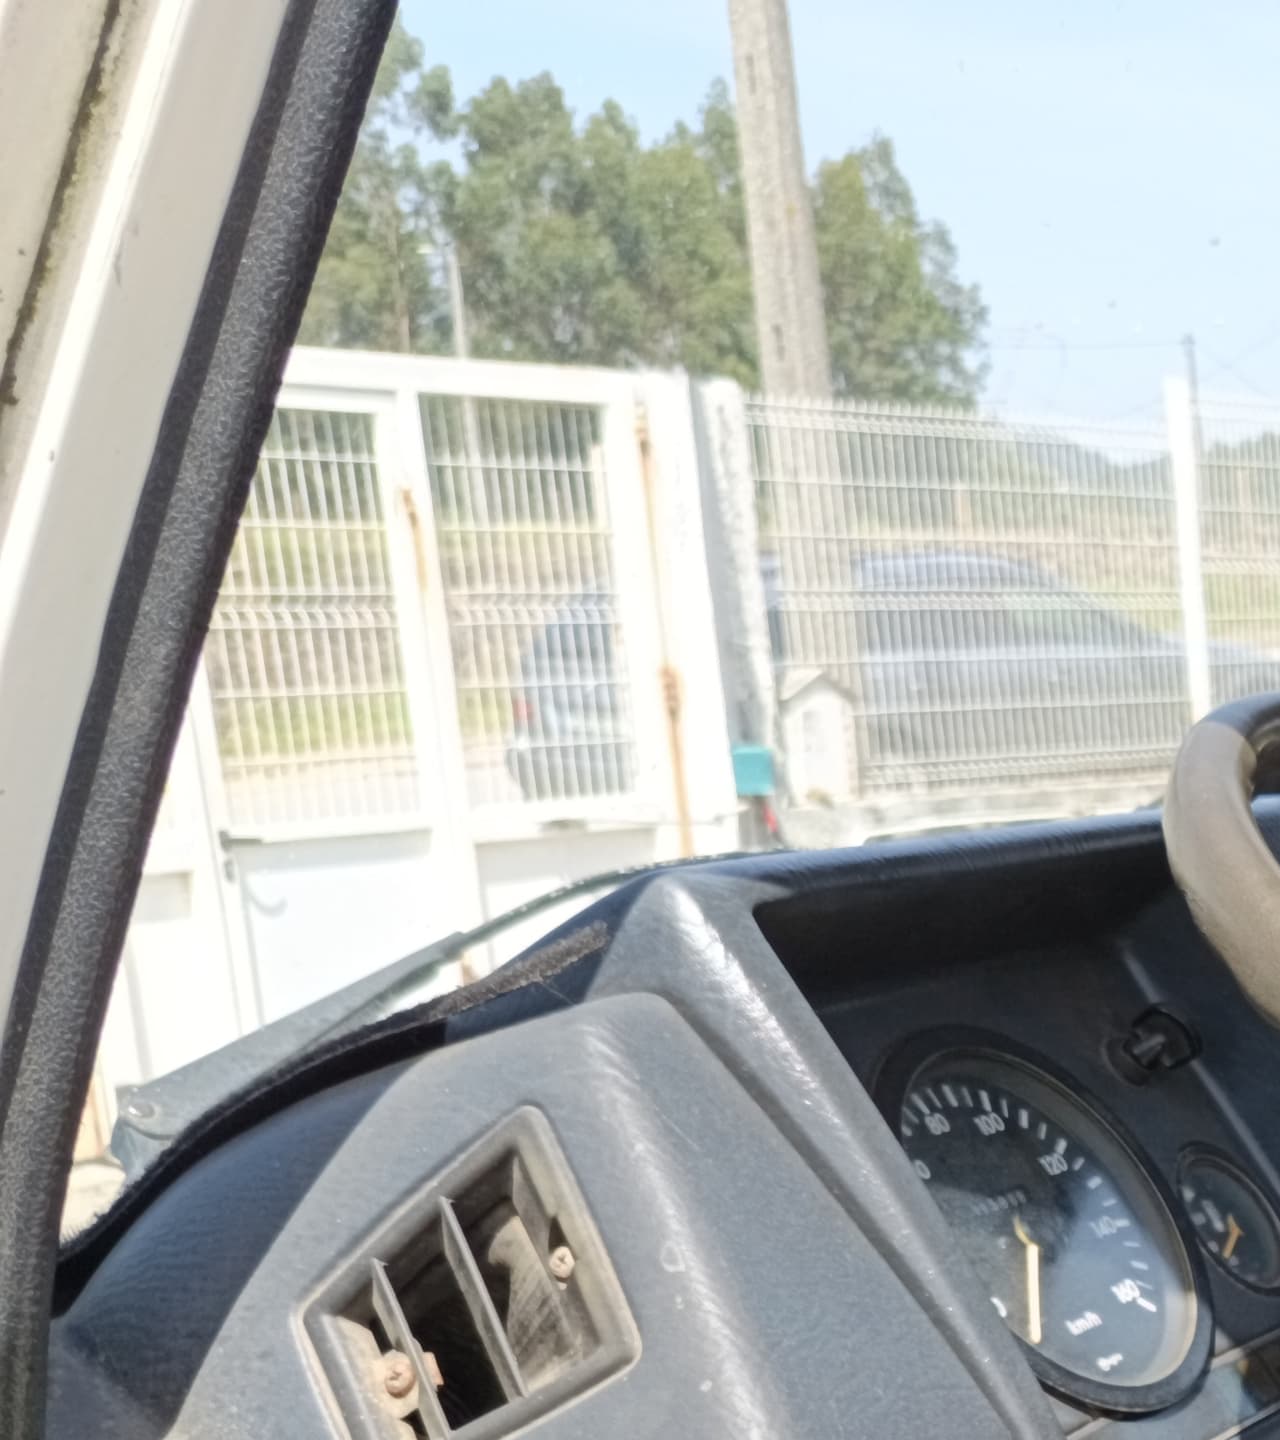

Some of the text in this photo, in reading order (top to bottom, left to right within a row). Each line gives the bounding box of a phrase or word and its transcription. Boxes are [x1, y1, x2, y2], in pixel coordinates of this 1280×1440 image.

[924, 1112, 950, 1135] 80
[974, 1112, 1005, 1136] 100
[1038, 1153, 1068, 1176] 120
[1110, 1278, 1141, 1304] 160
[1065, 1311, 1102, 1336] km/h
